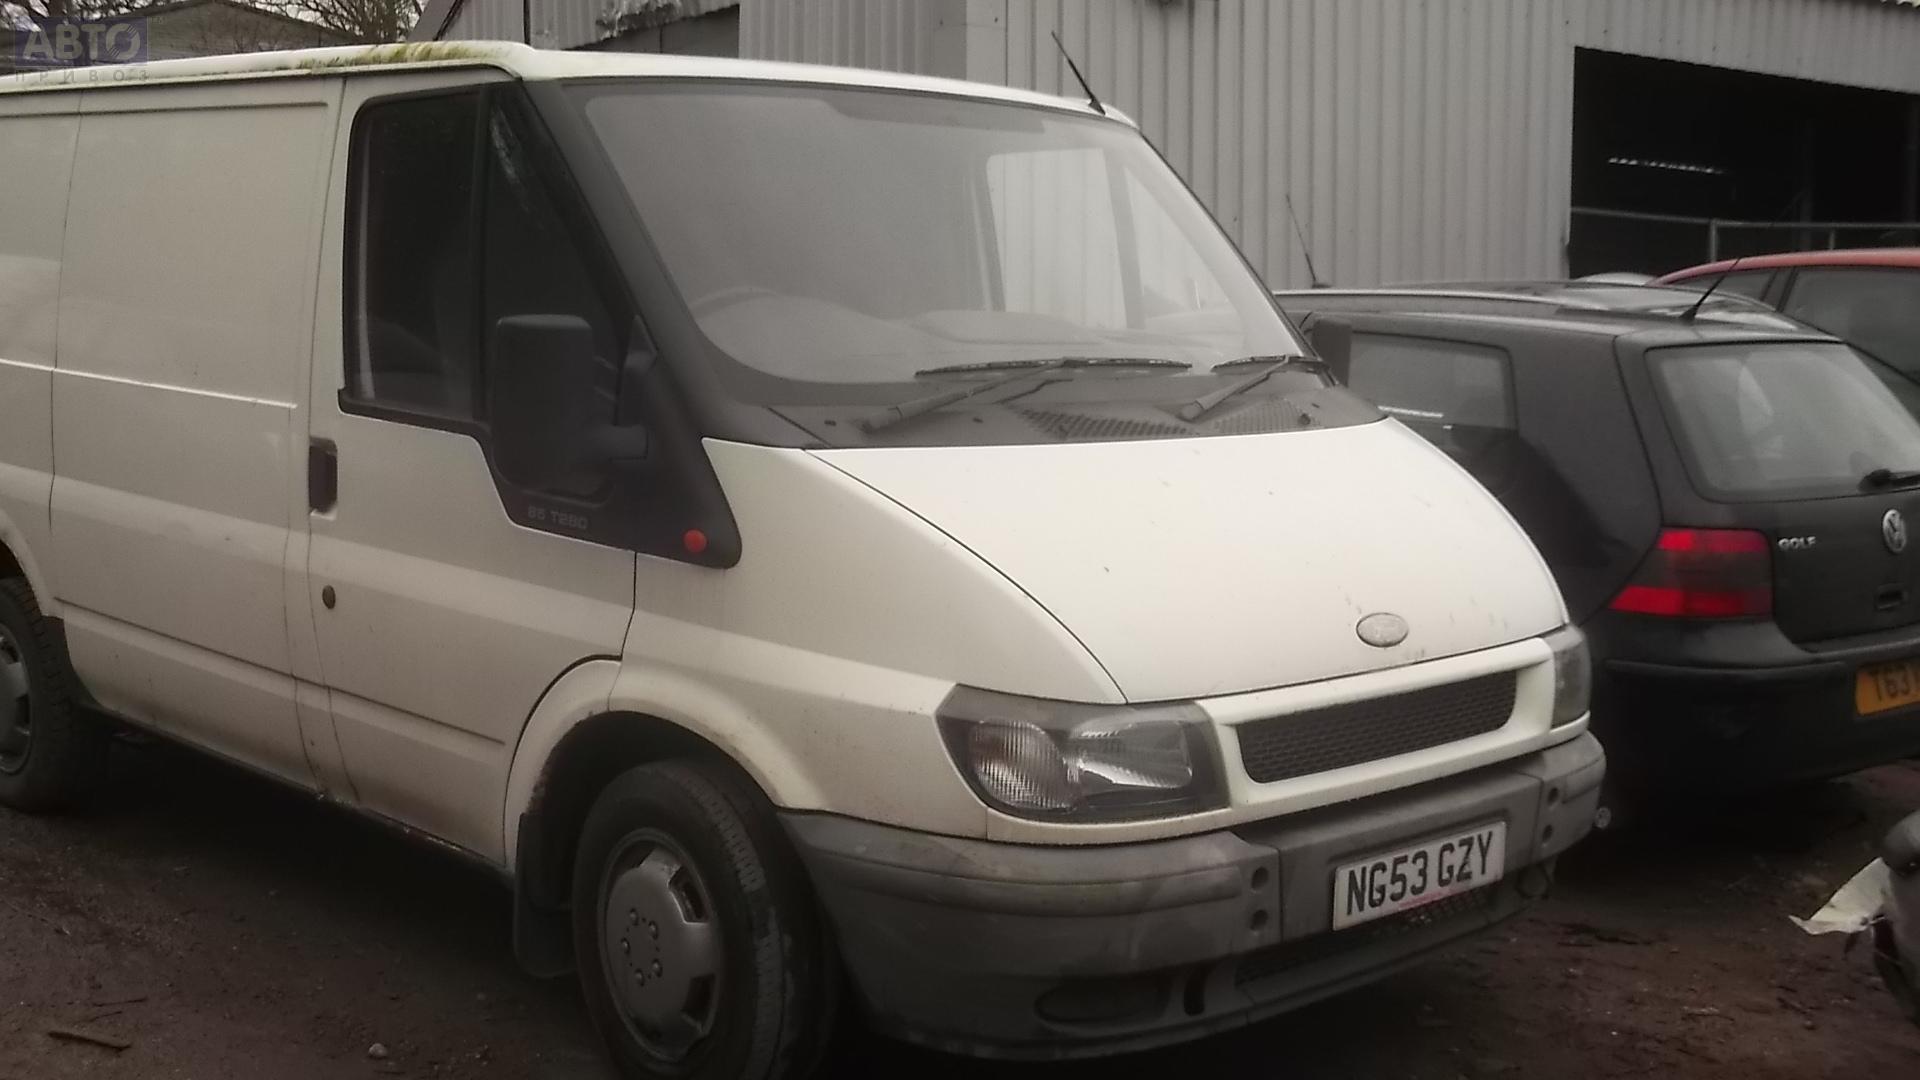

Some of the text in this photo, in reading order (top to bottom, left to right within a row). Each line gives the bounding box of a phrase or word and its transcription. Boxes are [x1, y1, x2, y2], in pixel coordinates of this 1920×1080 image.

[550, 510, 589, 529] T280
[1778, 536, 1816, 551] GOLF
[1347, 831, 1493, 916] NG53 GZY
